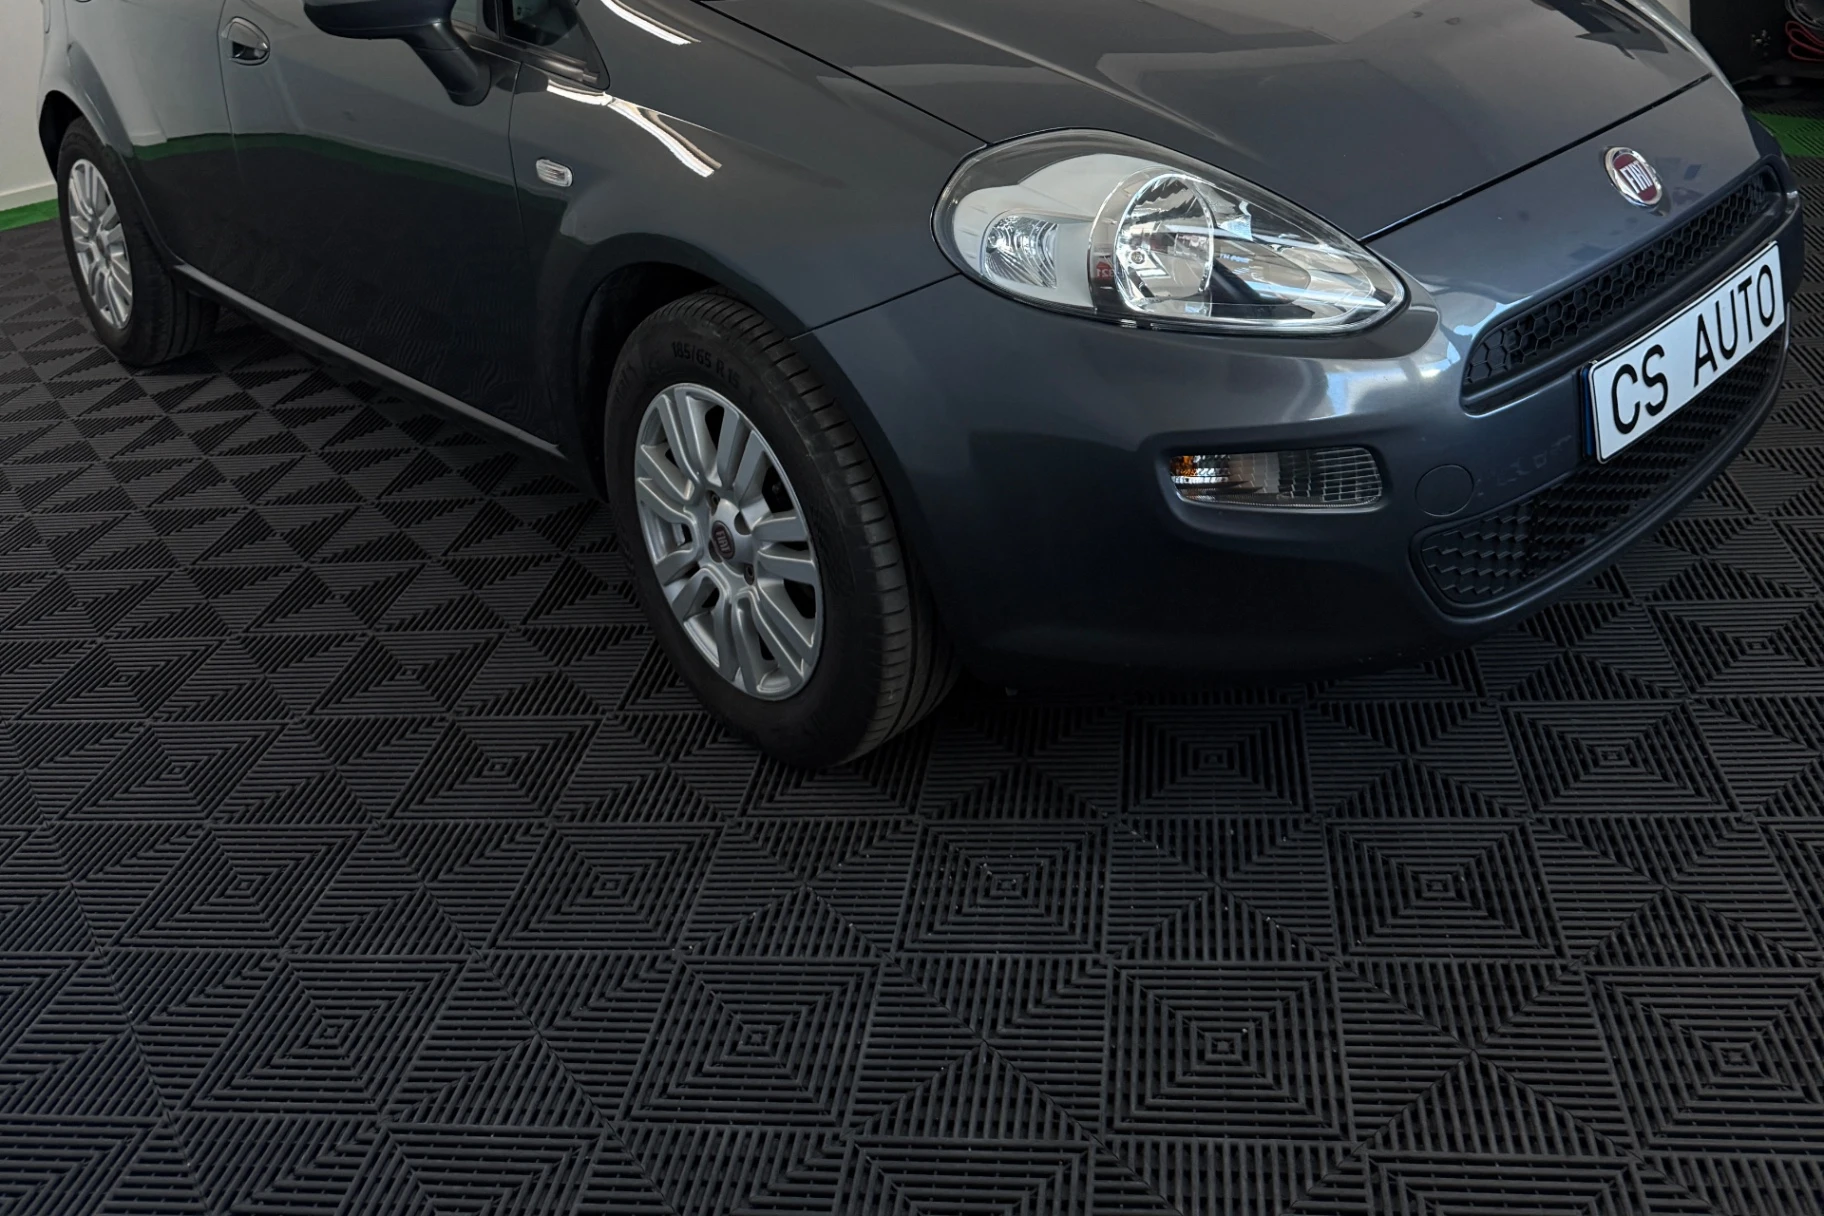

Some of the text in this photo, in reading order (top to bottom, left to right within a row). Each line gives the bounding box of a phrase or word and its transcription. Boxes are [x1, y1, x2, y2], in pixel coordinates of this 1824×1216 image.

[1619, 160, 1654, 194] FIAT
[671, 341, 741, 389] 185/65 R 15
[1611, 264, 1776, 435] CS AUTO
